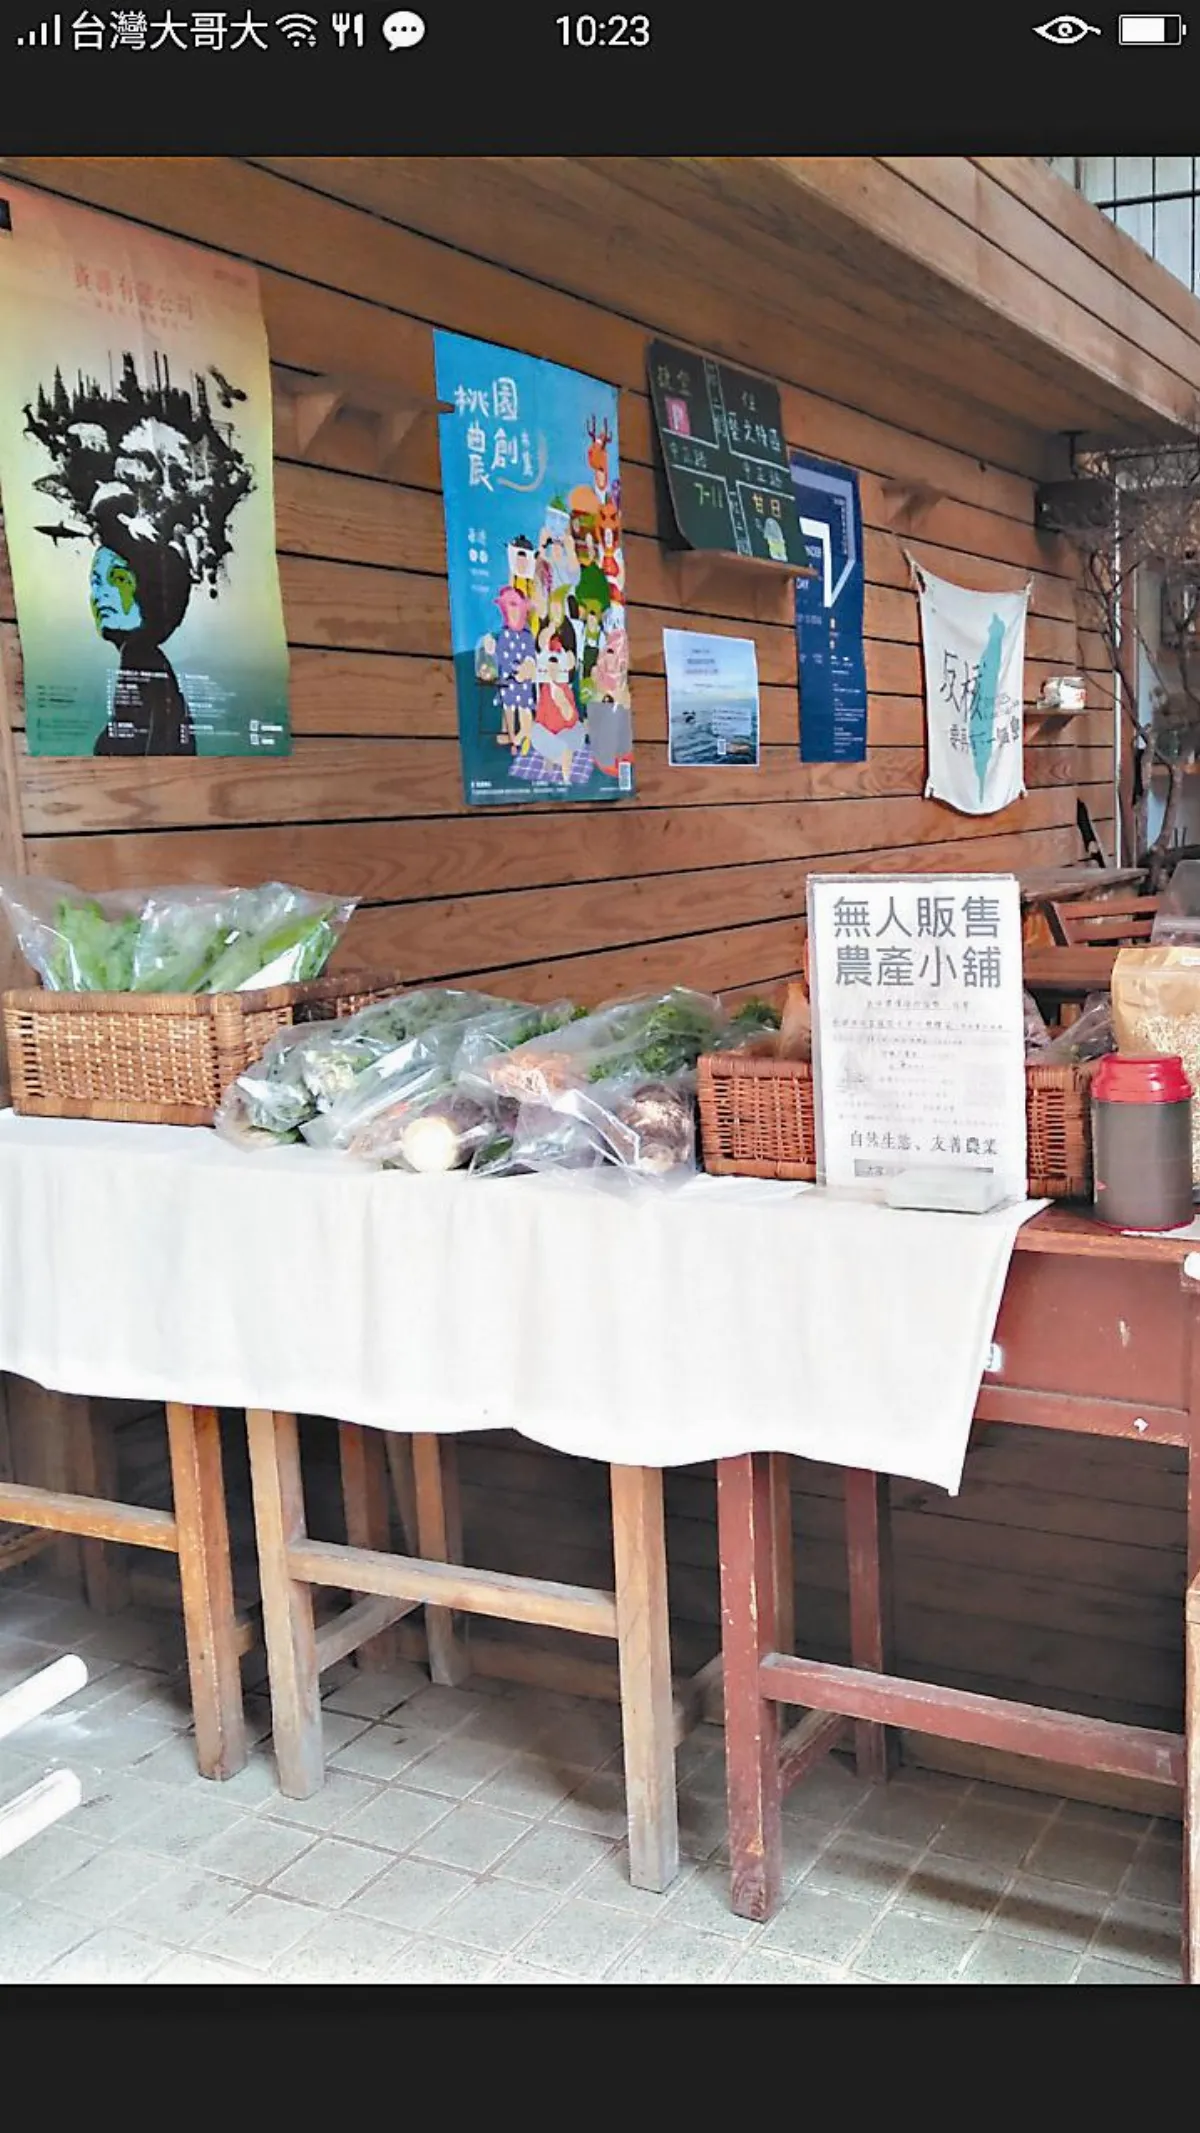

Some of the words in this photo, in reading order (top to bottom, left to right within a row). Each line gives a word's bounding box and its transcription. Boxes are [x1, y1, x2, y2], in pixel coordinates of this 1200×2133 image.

[454, 376, 518, 422] 桃園
[833, 896, 1001, 938] 無人販售
[835, 945, 1002, 989] 農產小舖
